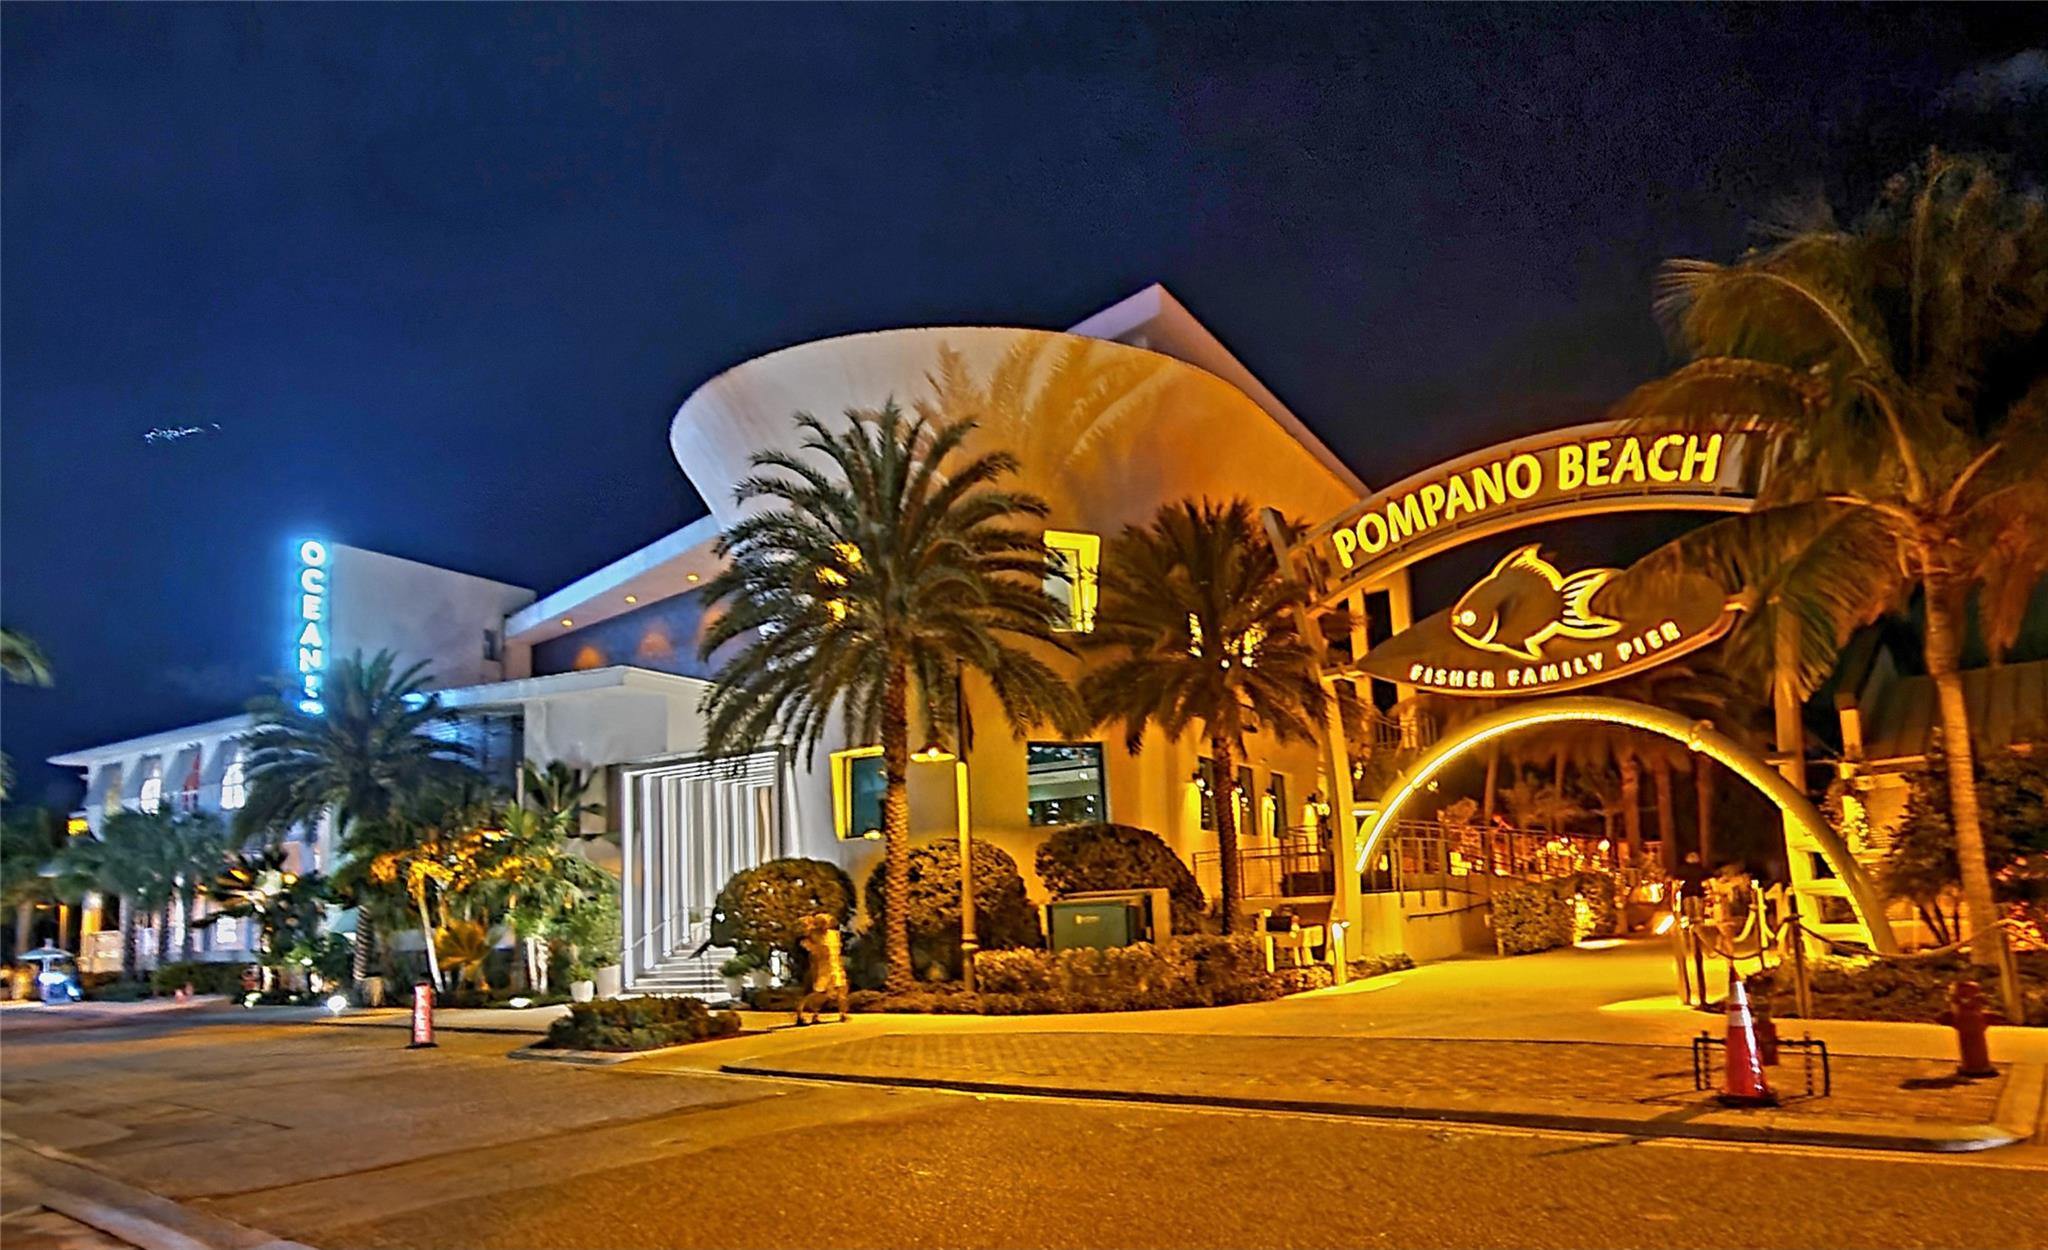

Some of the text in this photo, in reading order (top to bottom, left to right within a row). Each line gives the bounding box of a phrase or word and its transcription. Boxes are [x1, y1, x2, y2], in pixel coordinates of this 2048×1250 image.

[1332, 433, 1722, 568] POMPANO BEACH
[1409, 621, 1681, 688] FISHER FAMILY PIER
